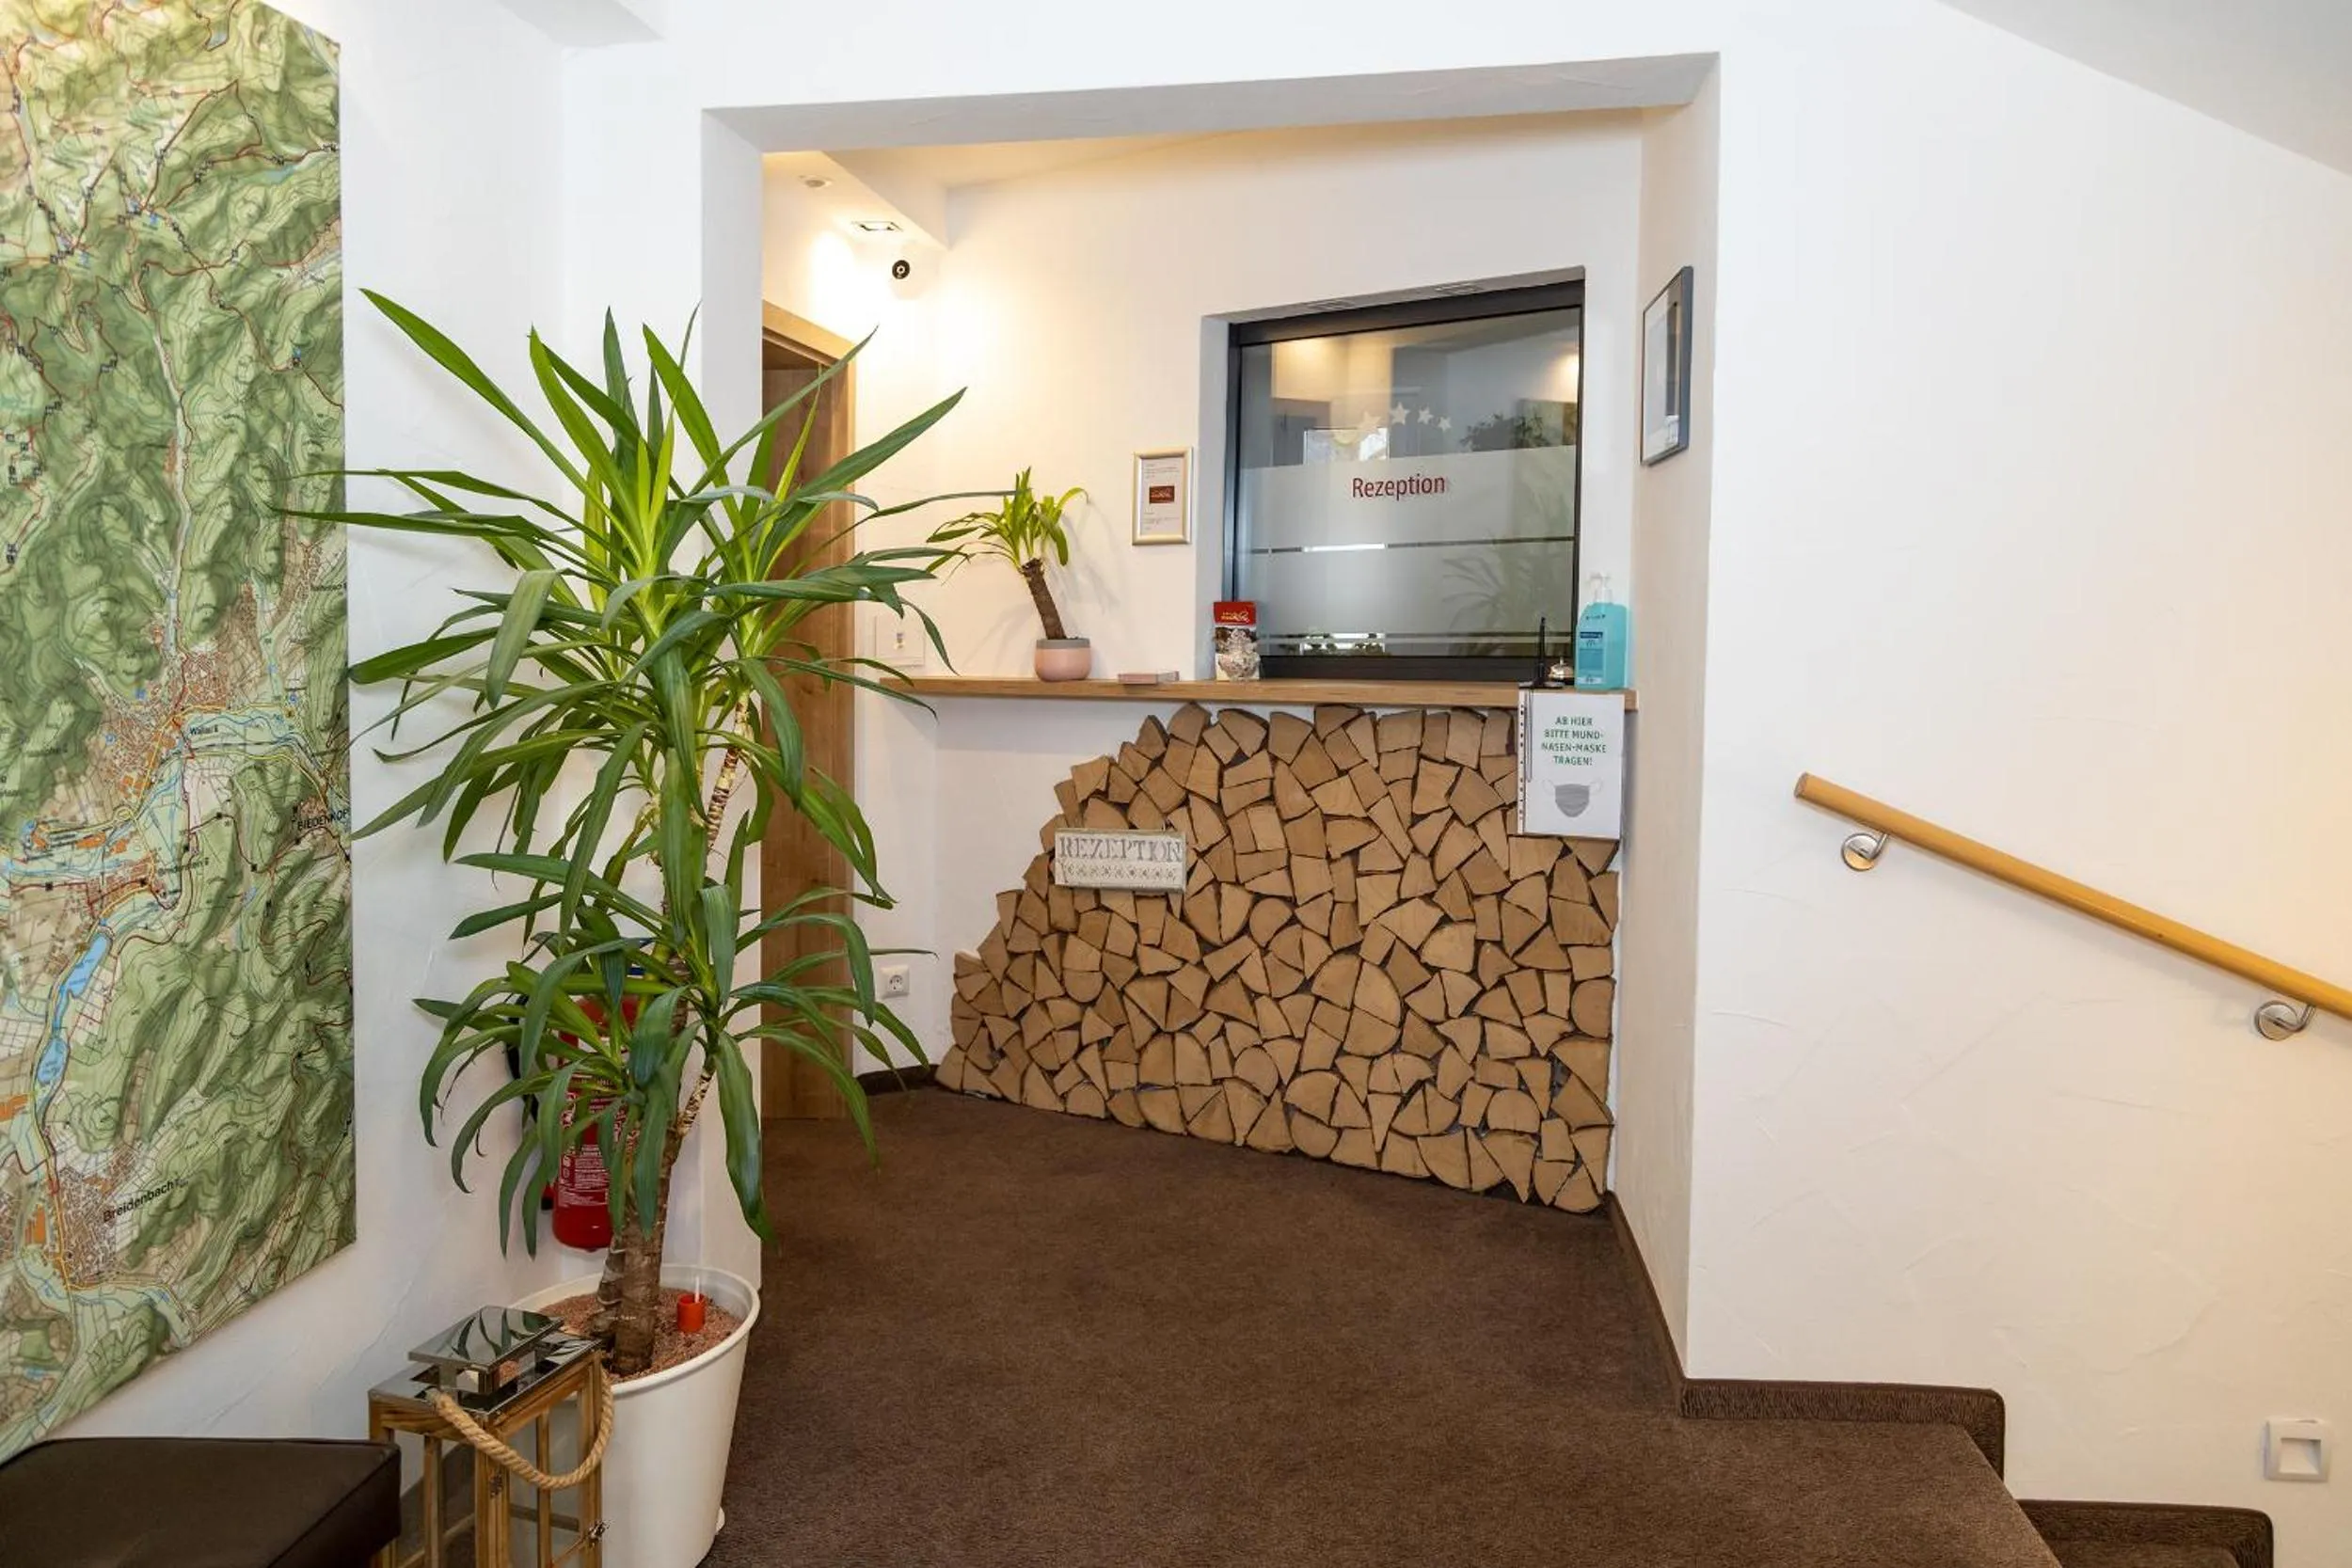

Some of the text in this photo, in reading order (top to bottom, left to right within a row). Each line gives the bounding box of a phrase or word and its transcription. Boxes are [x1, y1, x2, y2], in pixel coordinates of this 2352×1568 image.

[1352, 473, 1445, 501] Rezeption
[1554, 716, 1593, 726] AB HIER
[1543, 729, 1604, 739] BITTE MUND-
[1541, 742, 1607, 753] NASEN-MASKE
[1553, 755, 1593, 766] TRAGEN!
[1059, 836, 1183, 863] REZEPTION
[103, 1180, 174, 1222] Breidenbach
